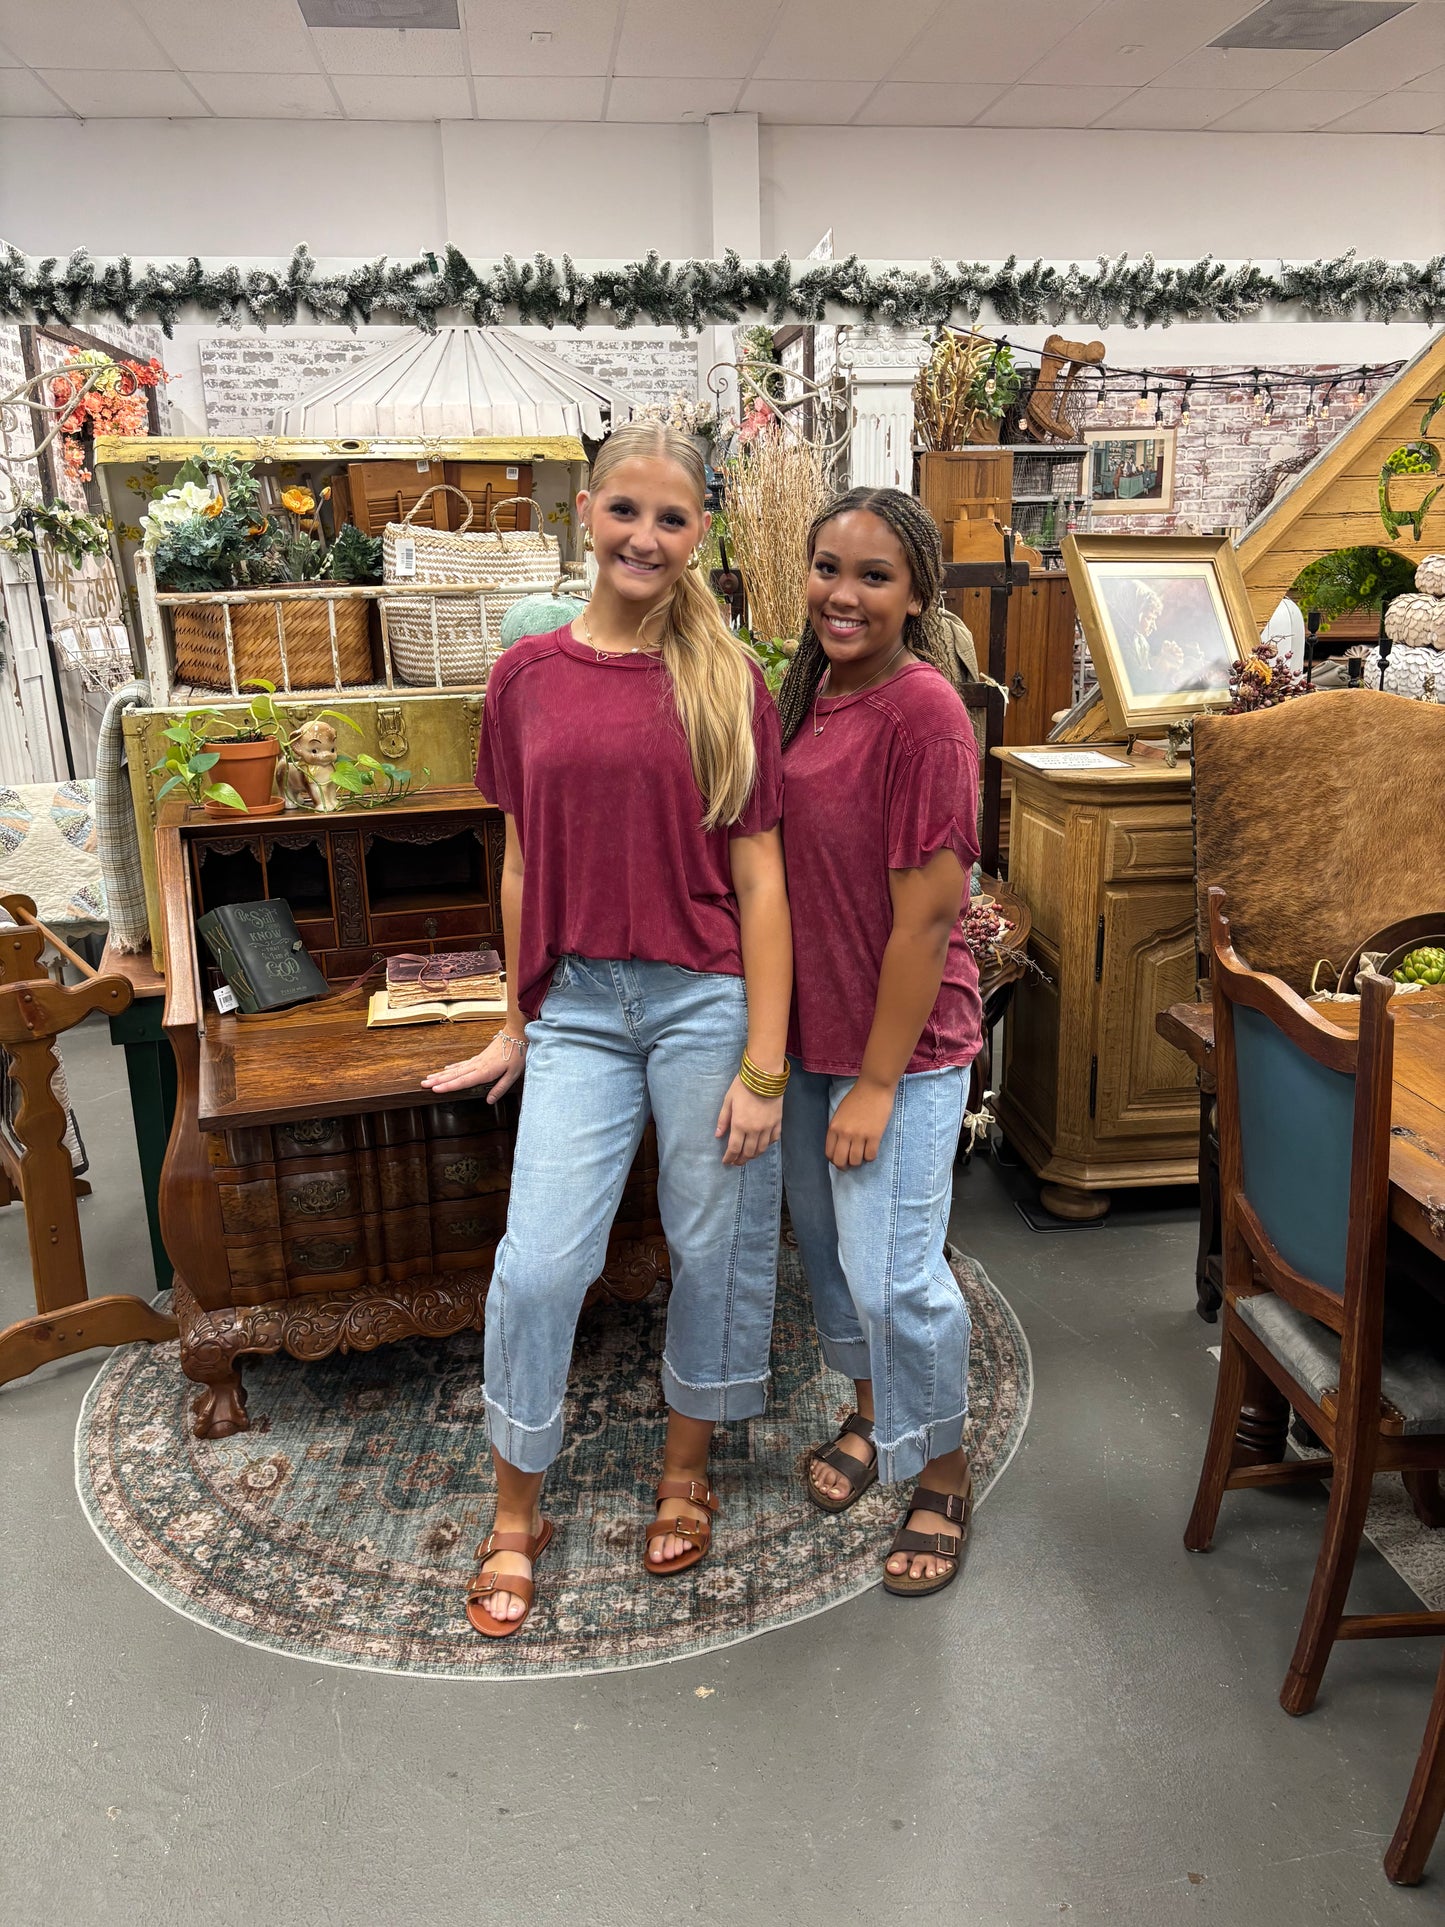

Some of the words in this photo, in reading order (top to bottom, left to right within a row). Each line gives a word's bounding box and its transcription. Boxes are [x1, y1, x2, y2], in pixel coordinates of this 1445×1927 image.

[43, 533, 77, 612] SHE
[234, 908, 250, 922] Be
[249, 908, 276, 928] Still
[249, 929, 281, 941] KNOW
[265, 957, 300, 980] GOD
